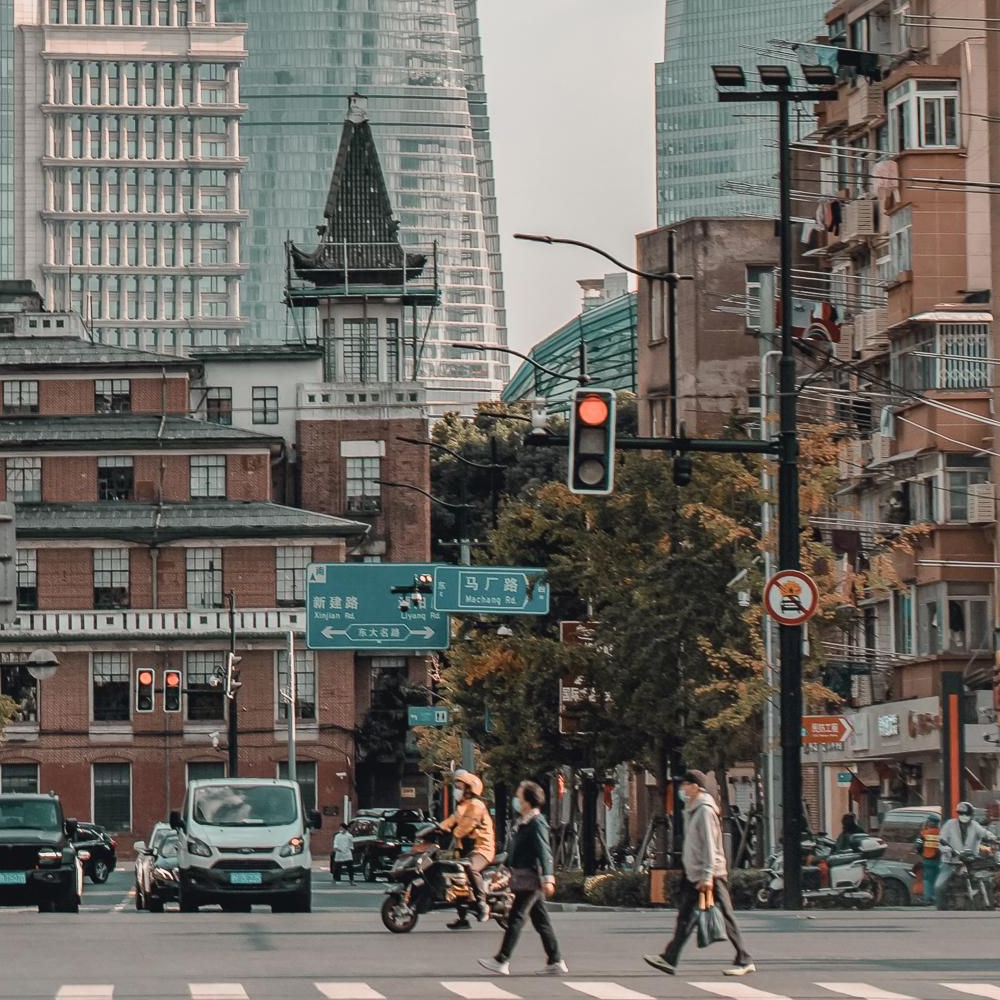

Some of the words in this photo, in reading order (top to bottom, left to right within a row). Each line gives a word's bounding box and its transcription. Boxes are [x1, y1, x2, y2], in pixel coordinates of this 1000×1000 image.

[464, 576, 519, 593] 马厂路
[312, 595, 359, 609] 新建路
[464, 594, 502, 606] Machang
[314, 611, 341, 621] Xinjian
[400, 612, 426, 621] Liyang
[358, 627, 400, 638] 东大名路
